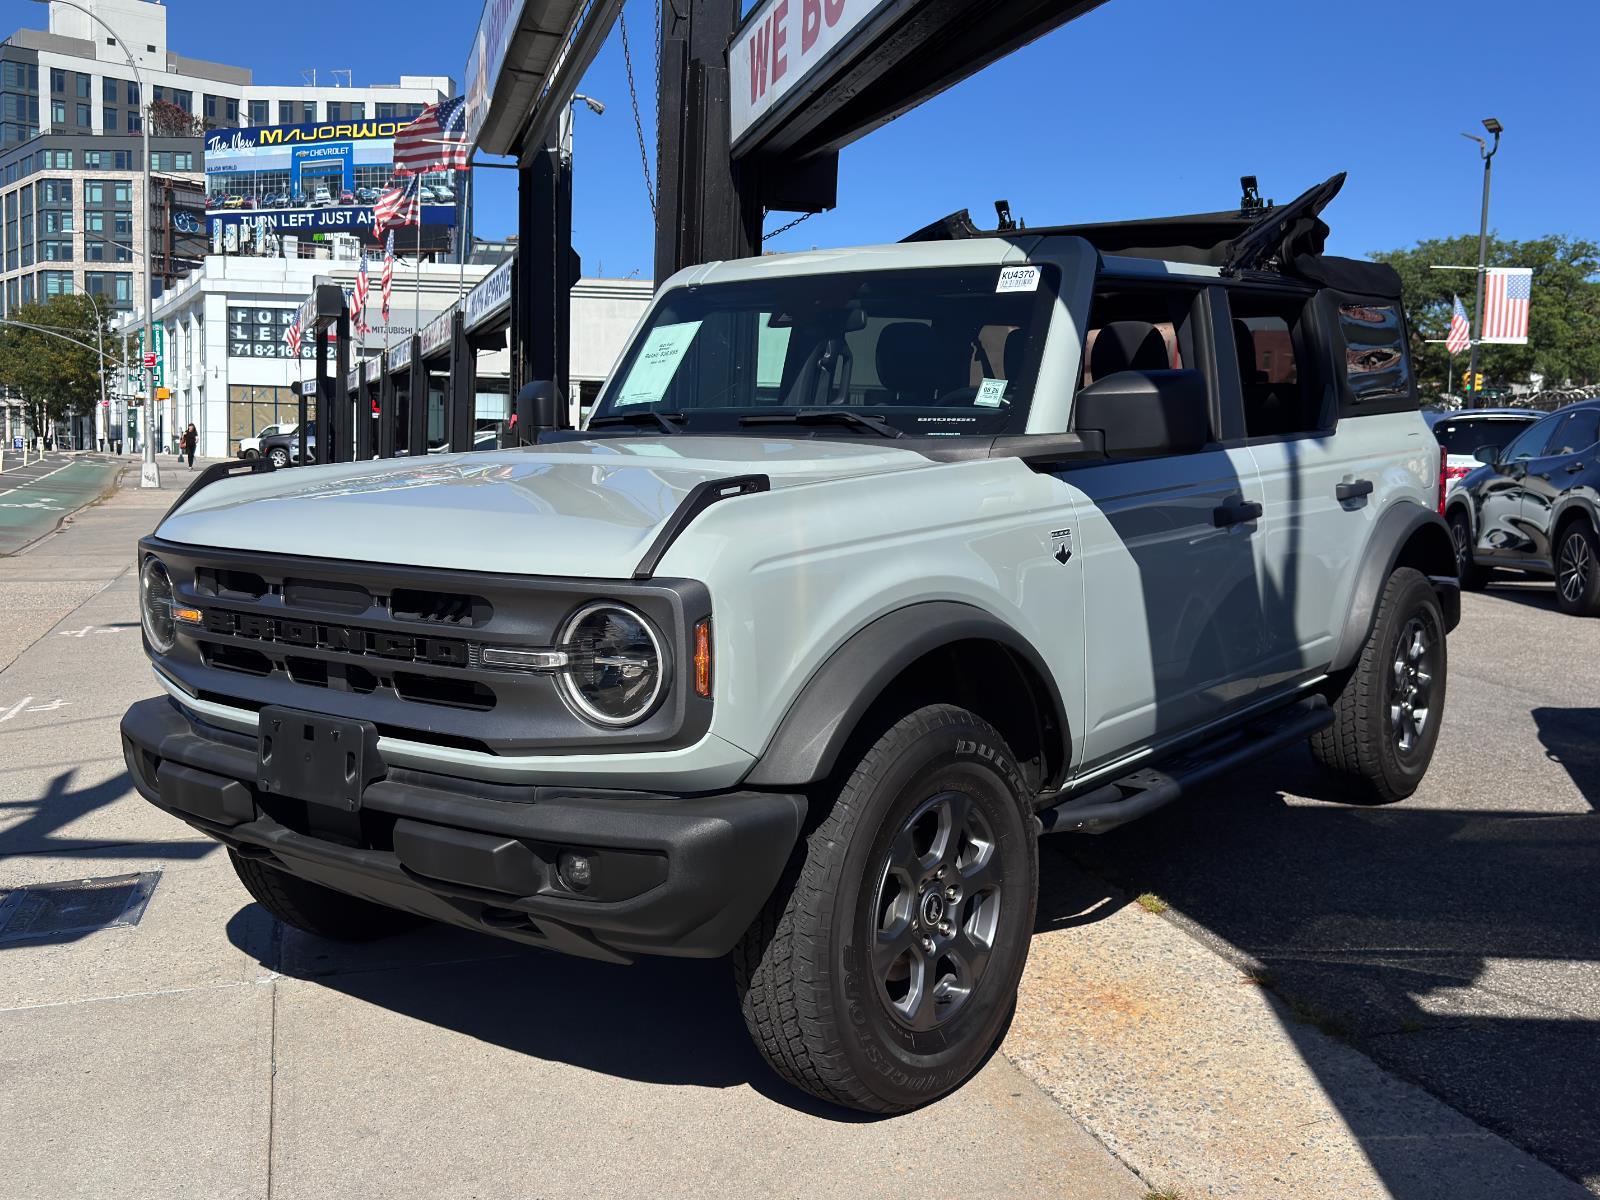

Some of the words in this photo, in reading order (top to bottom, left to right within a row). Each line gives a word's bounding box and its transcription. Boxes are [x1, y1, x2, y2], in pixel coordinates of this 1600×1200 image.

[750, 0, 788, 106] WE
[208, 135, 229, 154] The
[231, 131, 256, 151] New
[309, 146, 349, 157] CHEVROLET
[241, 214, 277, 229] TURN
[281, 213, 314, 228] LEFT
[318, 211, 352, 226] JUST
[1001, 270, 1035, 280] KU4370
[237, 310, 294, 324] FOR
[236, 325, 314, 342] LEAS
[206, 607, 469, 668] BRONCO
